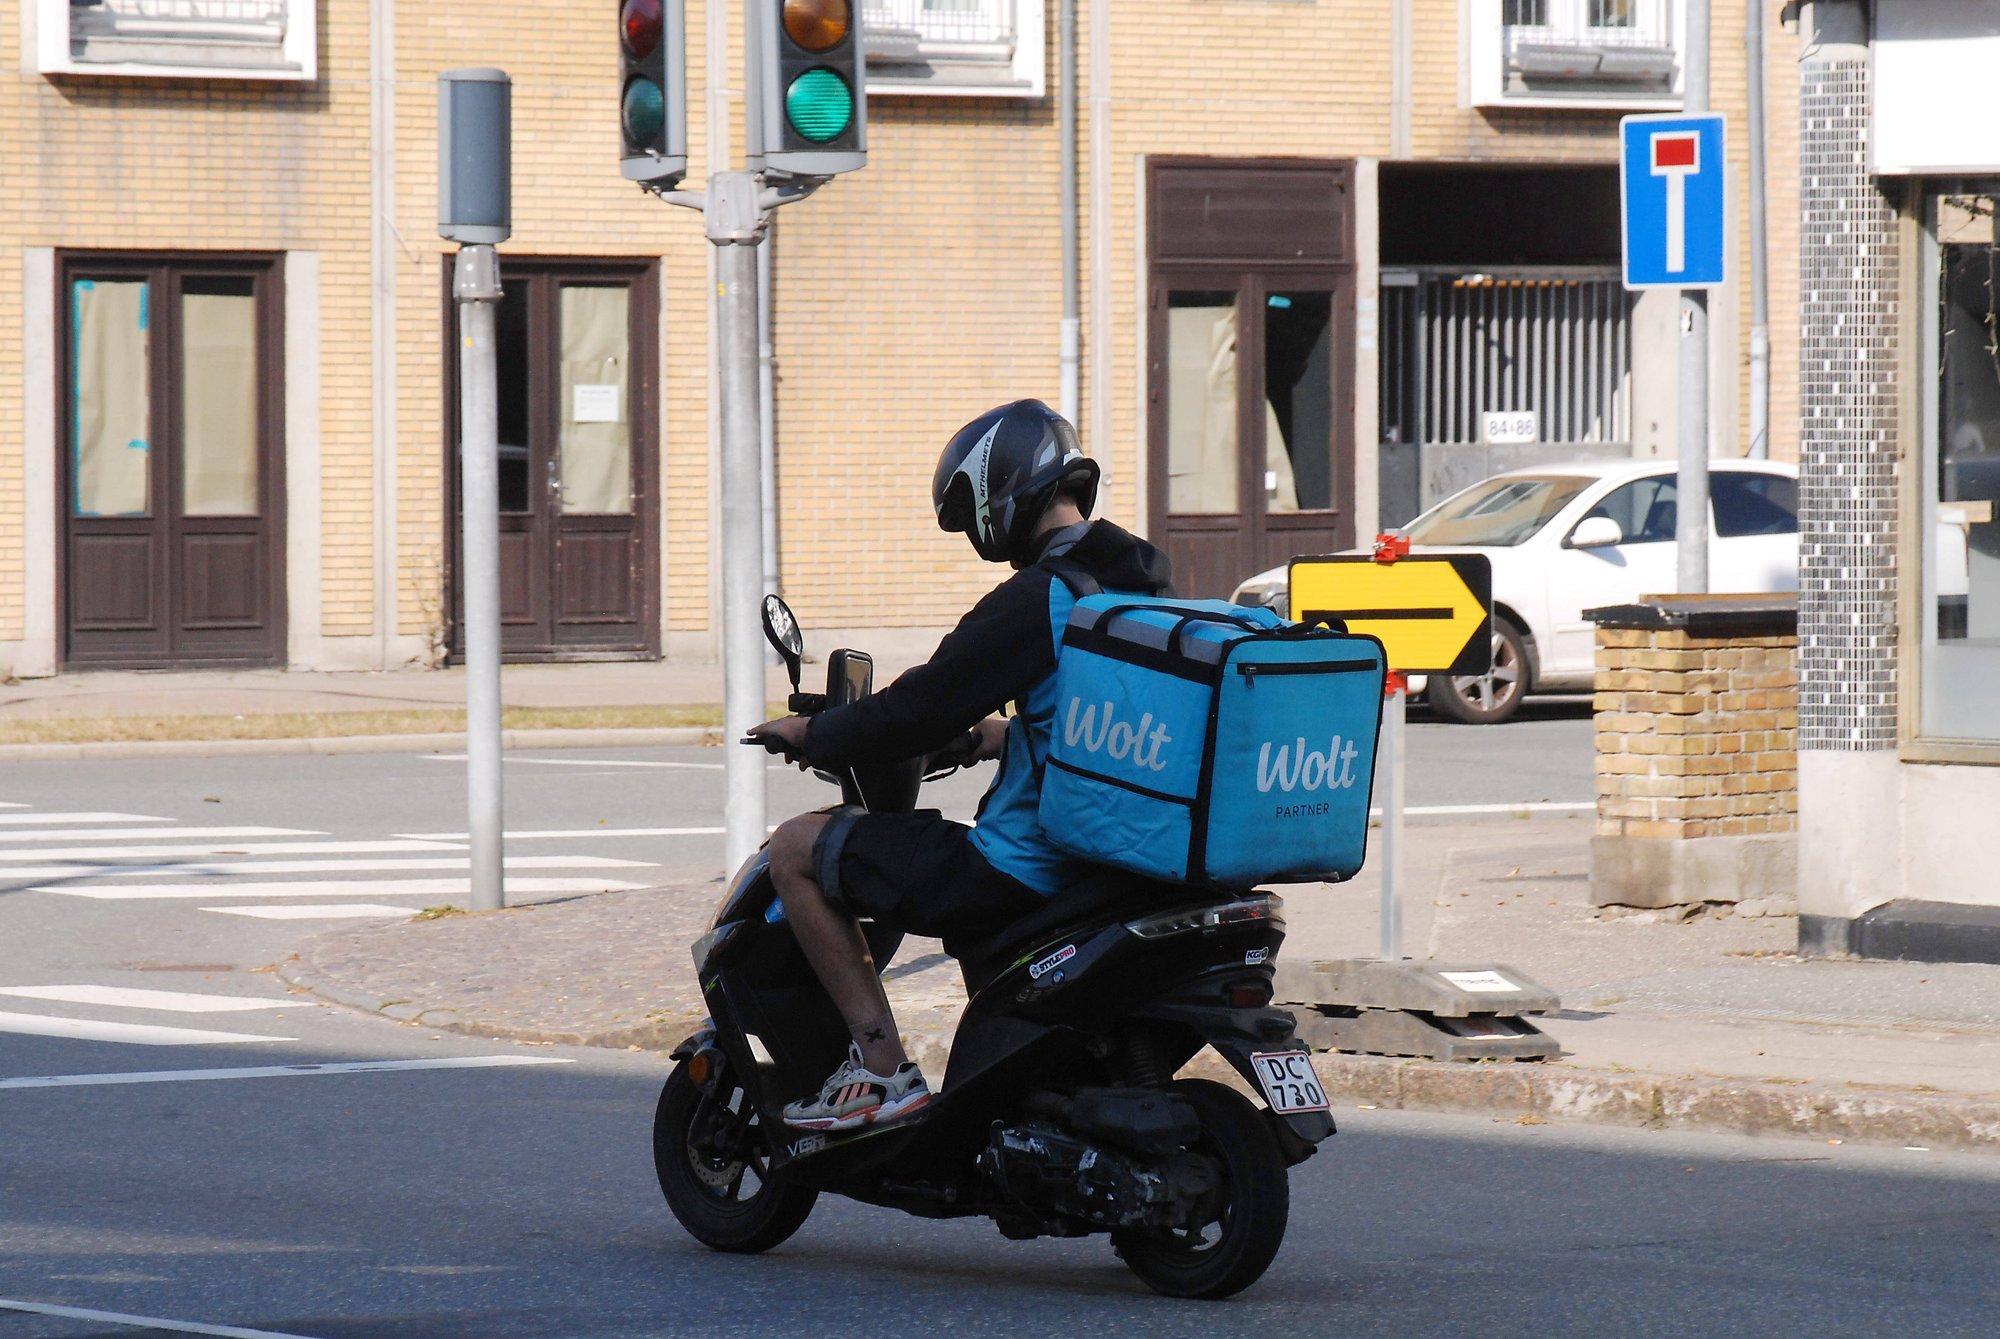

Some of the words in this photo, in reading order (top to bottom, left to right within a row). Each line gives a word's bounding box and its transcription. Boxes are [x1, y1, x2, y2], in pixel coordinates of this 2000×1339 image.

[980, 436, 992, 499] MTHELMETS
[1064, 696, 1172, 772] Wolt
[1256, 734, 1359, 793] Wolt
[1276, 802, 1330, 818] PARTNER
[1266, 1056, 1304, 1081] DC
[1272, 1082, 1322, 1108] 730
